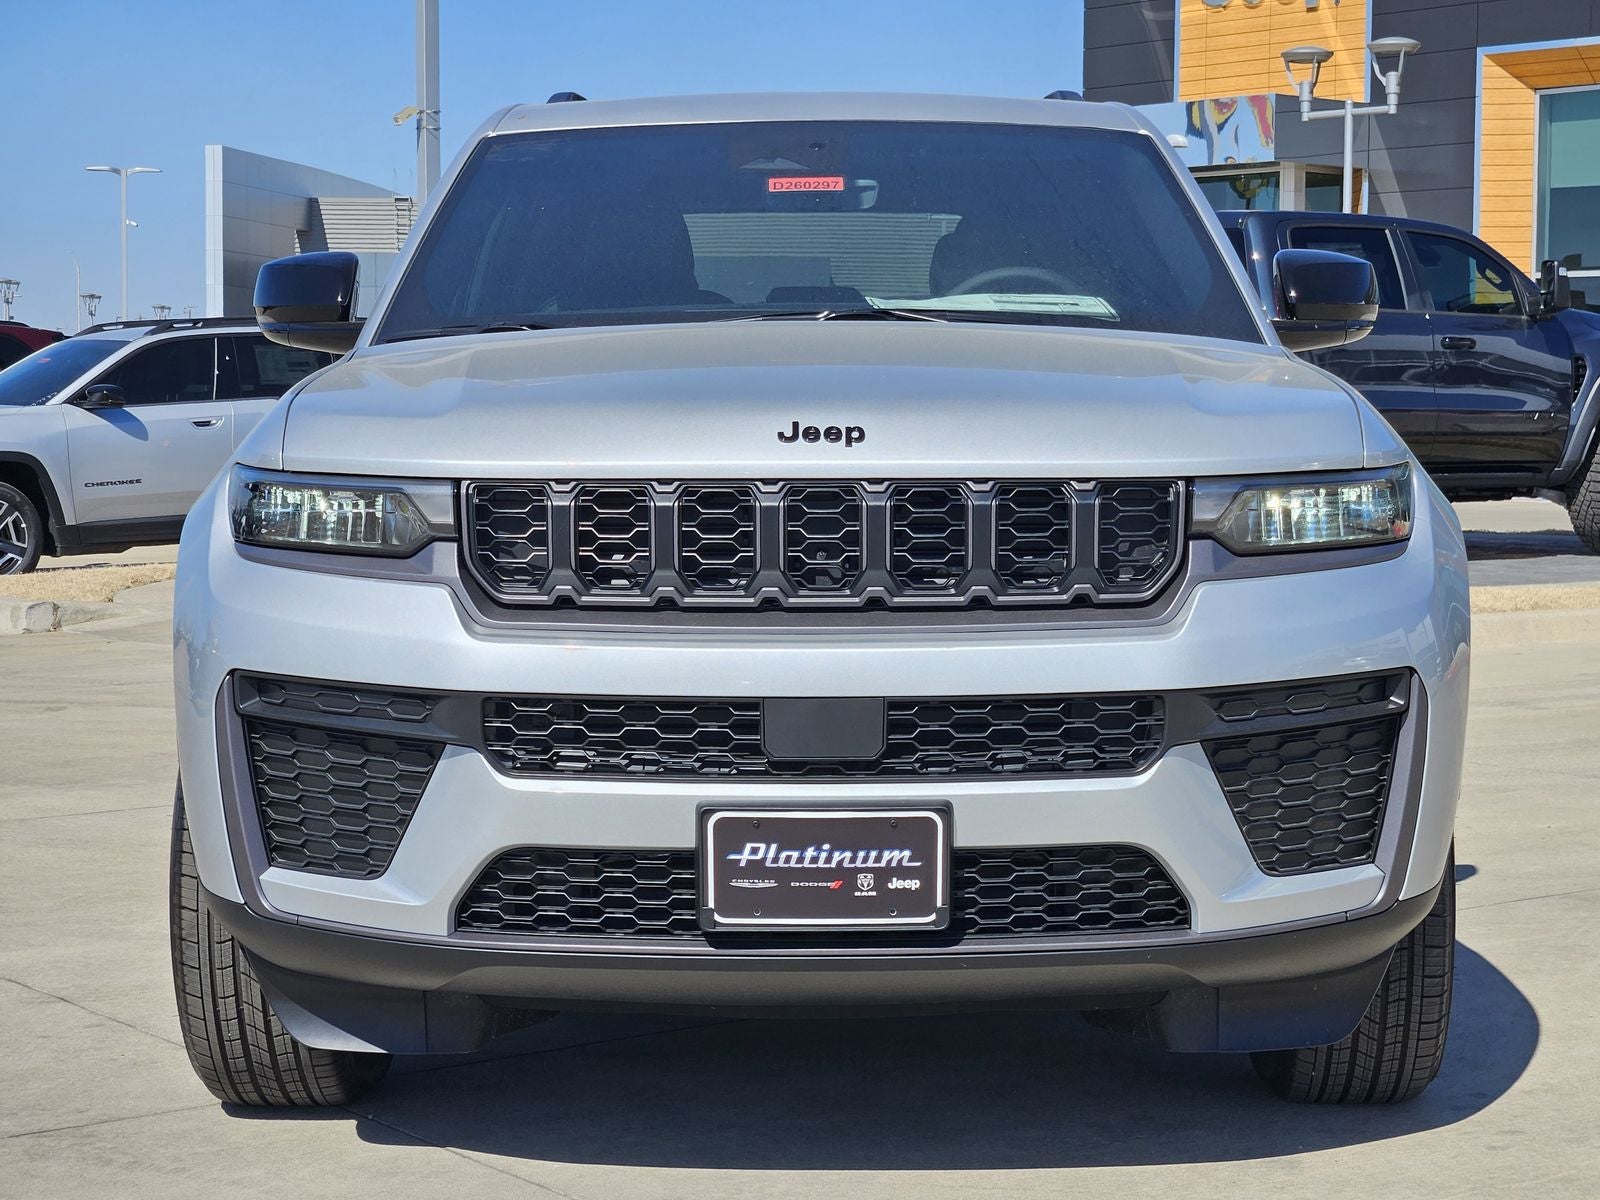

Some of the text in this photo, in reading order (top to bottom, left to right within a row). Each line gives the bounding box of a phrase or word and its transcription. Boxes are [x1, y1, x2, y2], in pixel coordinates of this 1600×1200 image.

[772, 181, 840, 190] D260297
[777, 420, 866, 448] Jeep
[84, 478, 143, 488] CHEROKEE
[726, 842, 922, 868] Platinum
[887, 877, 921, 891] Jeep
